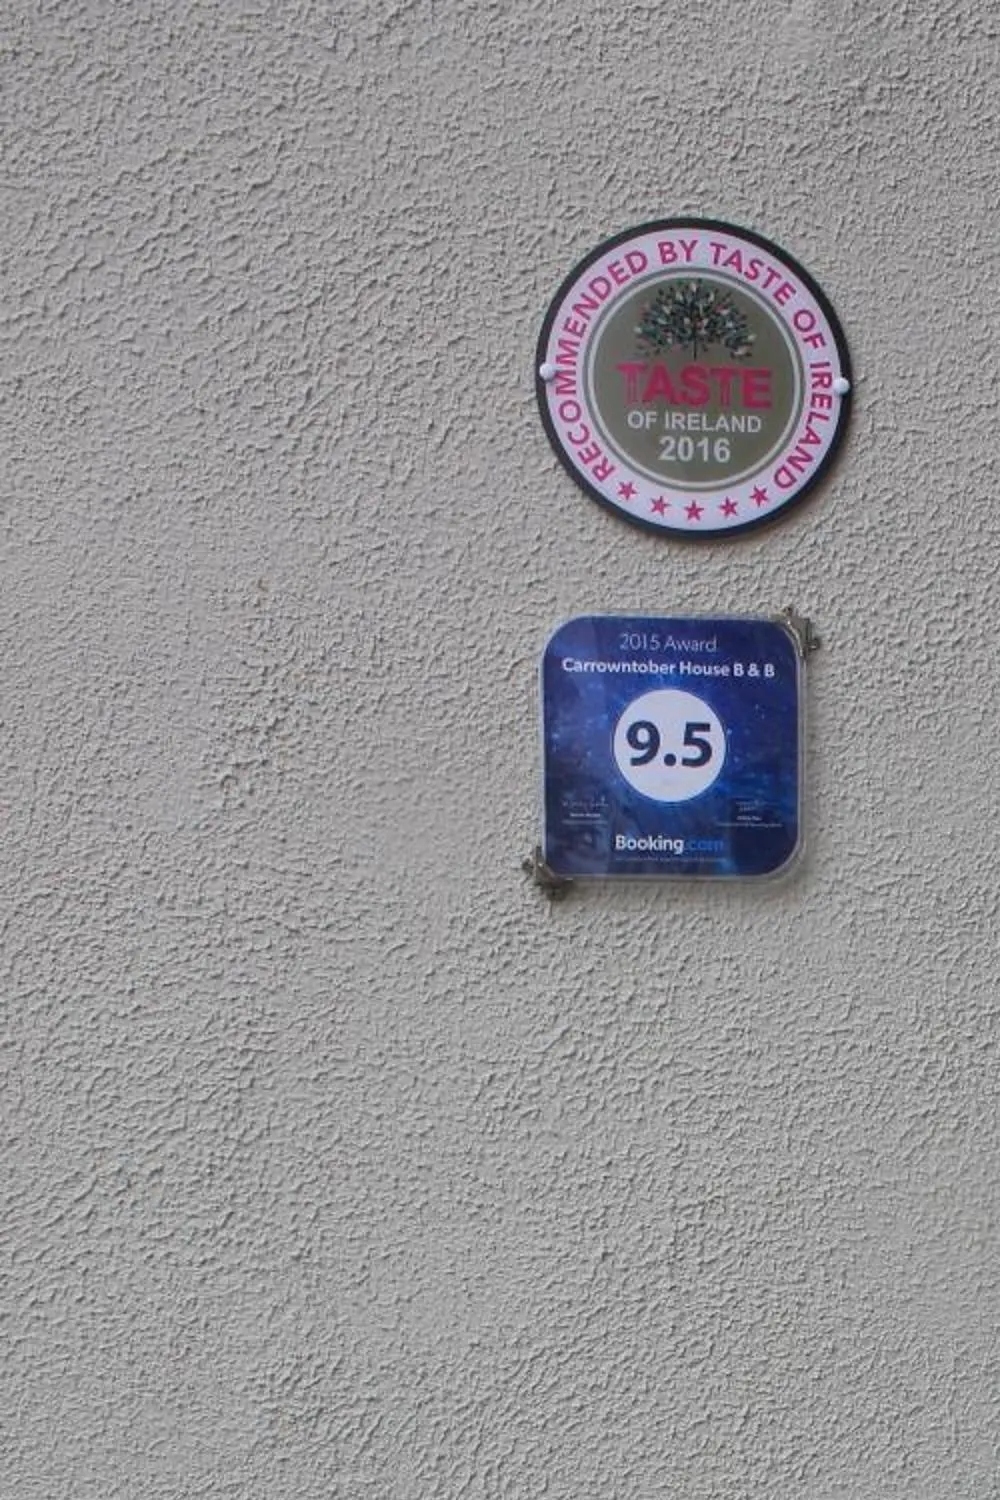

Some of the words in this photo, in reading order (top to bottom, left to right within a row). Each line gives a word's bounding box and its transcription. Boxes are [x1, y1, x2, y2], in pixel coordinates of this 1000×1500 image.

[657, 239, 699, 265] BY
[709, 242, 797, 306] TASTE
[793, 309, 827, 350] OF
[555, 250, 649, 482] RECOMMENDED
[615, 361, 773, 410] TASTE
[627, 410, 659, 429] OF
[664, 411, 762, 434] IRELAND
[773, 360, 833, 489] IRELAND
[658, 435, 731, 464] 2016
[619, 633, 661, 650] 2015
[664, 635, 717, 652] Award
[561, 657, 675, 675] Carrowntober
[679, 661, 730, 677] House
[733, 663, 744, 677] B
[748, 663, 761, 677] &
[764, 664, 776, 677] B
[625, 719, 713, 768] 9.5
